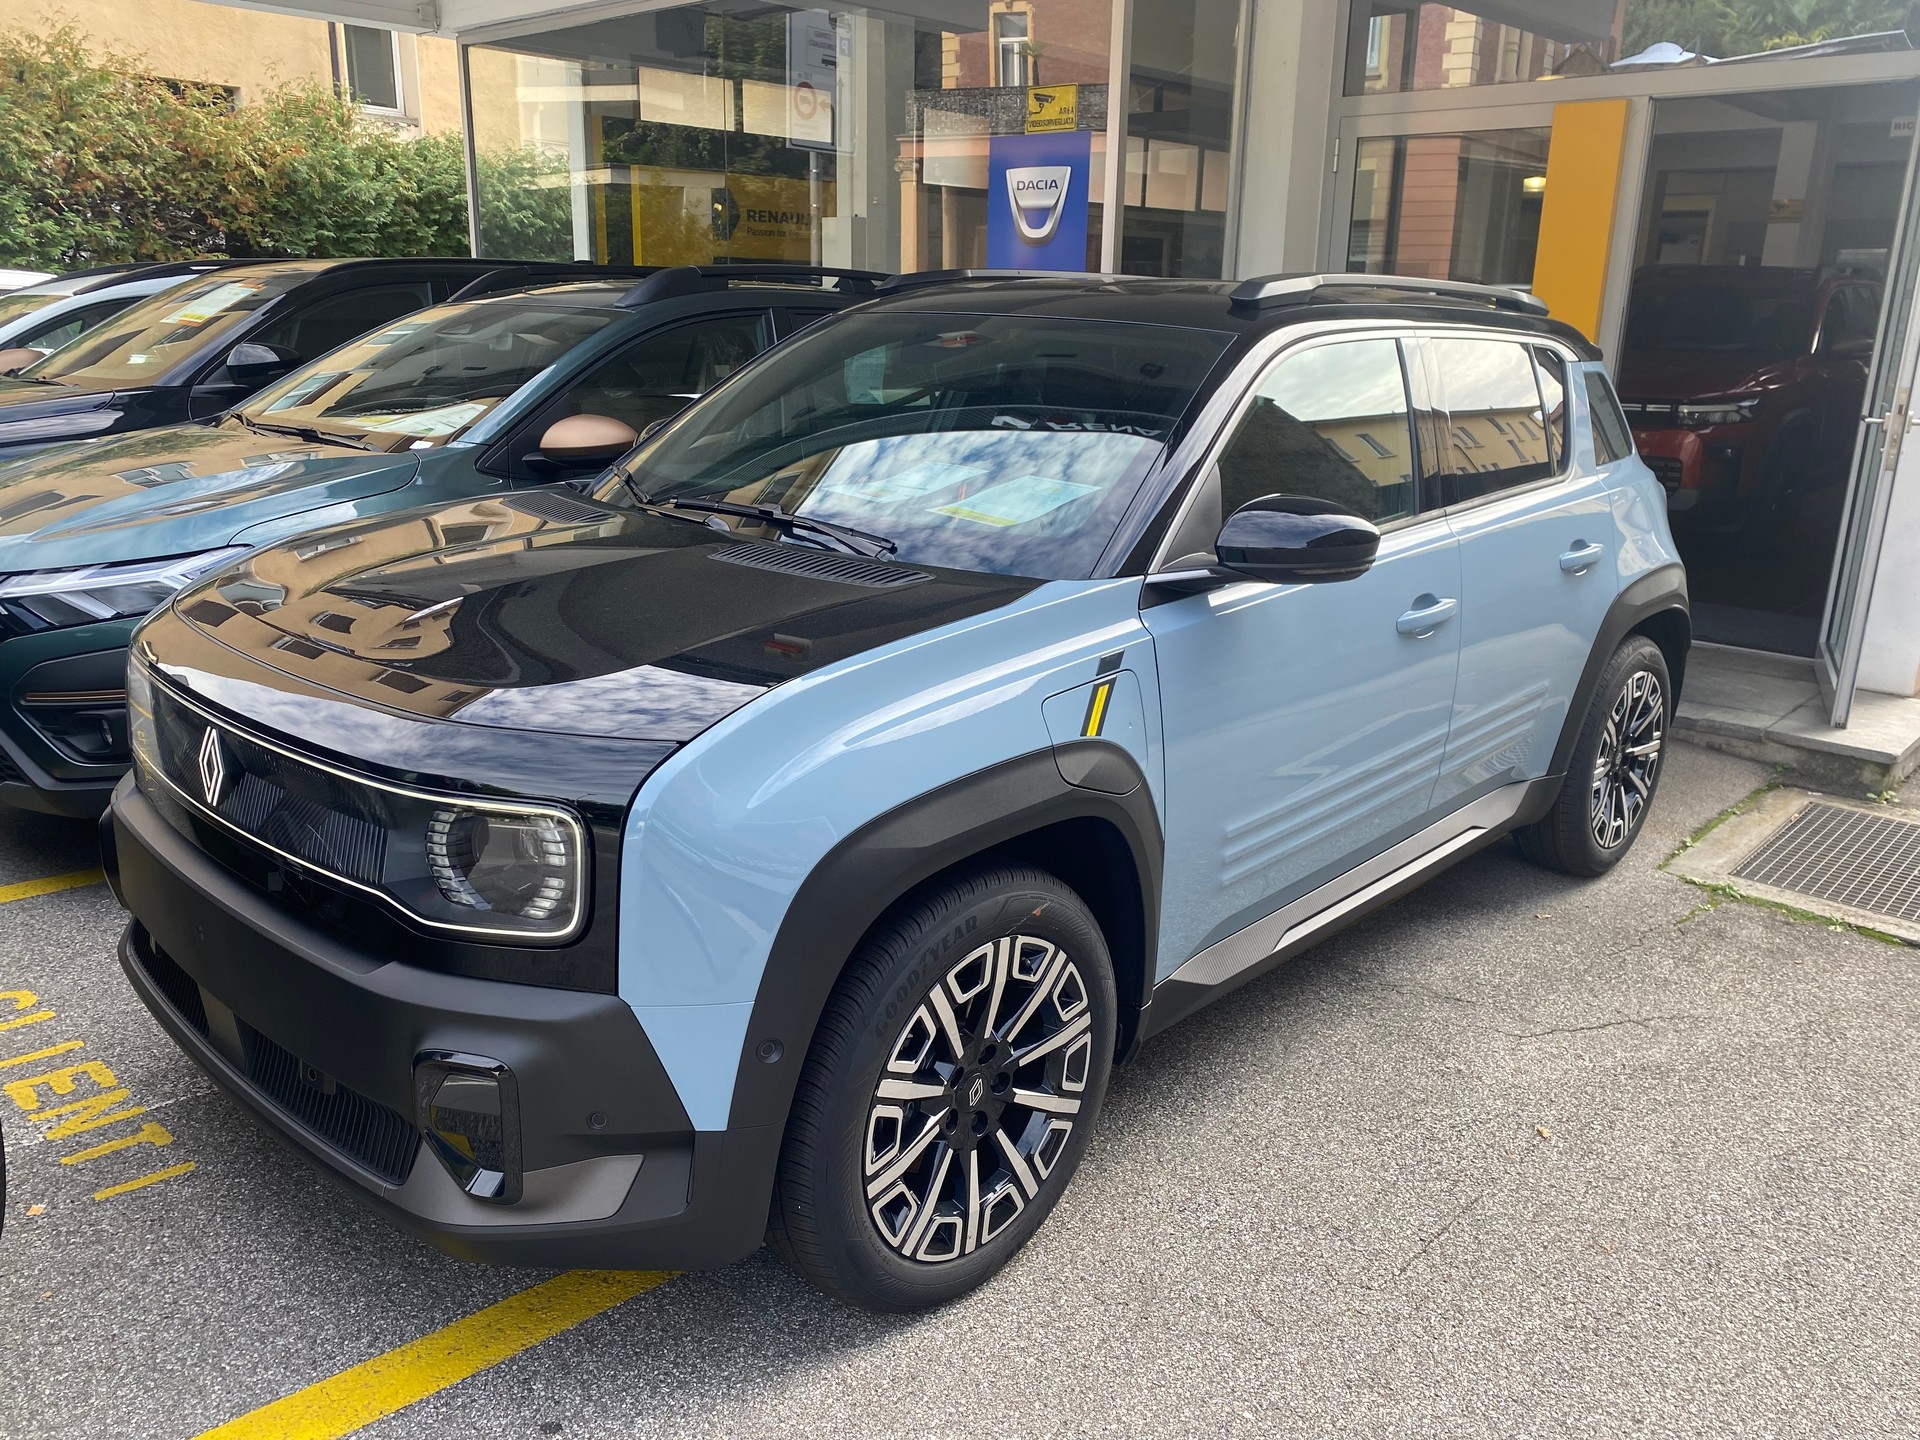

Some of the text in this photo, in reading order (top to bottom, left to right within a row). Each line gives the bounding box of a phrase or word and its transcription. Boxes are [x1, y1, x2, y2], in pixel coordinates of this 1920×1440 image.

[1059, 106, 1075, 115] AREA
[1016, 179, 1059, 191] DACIA
[746, 226, 776, 237] Passion
[874, 914, 979, 1038] GOODYEAR
